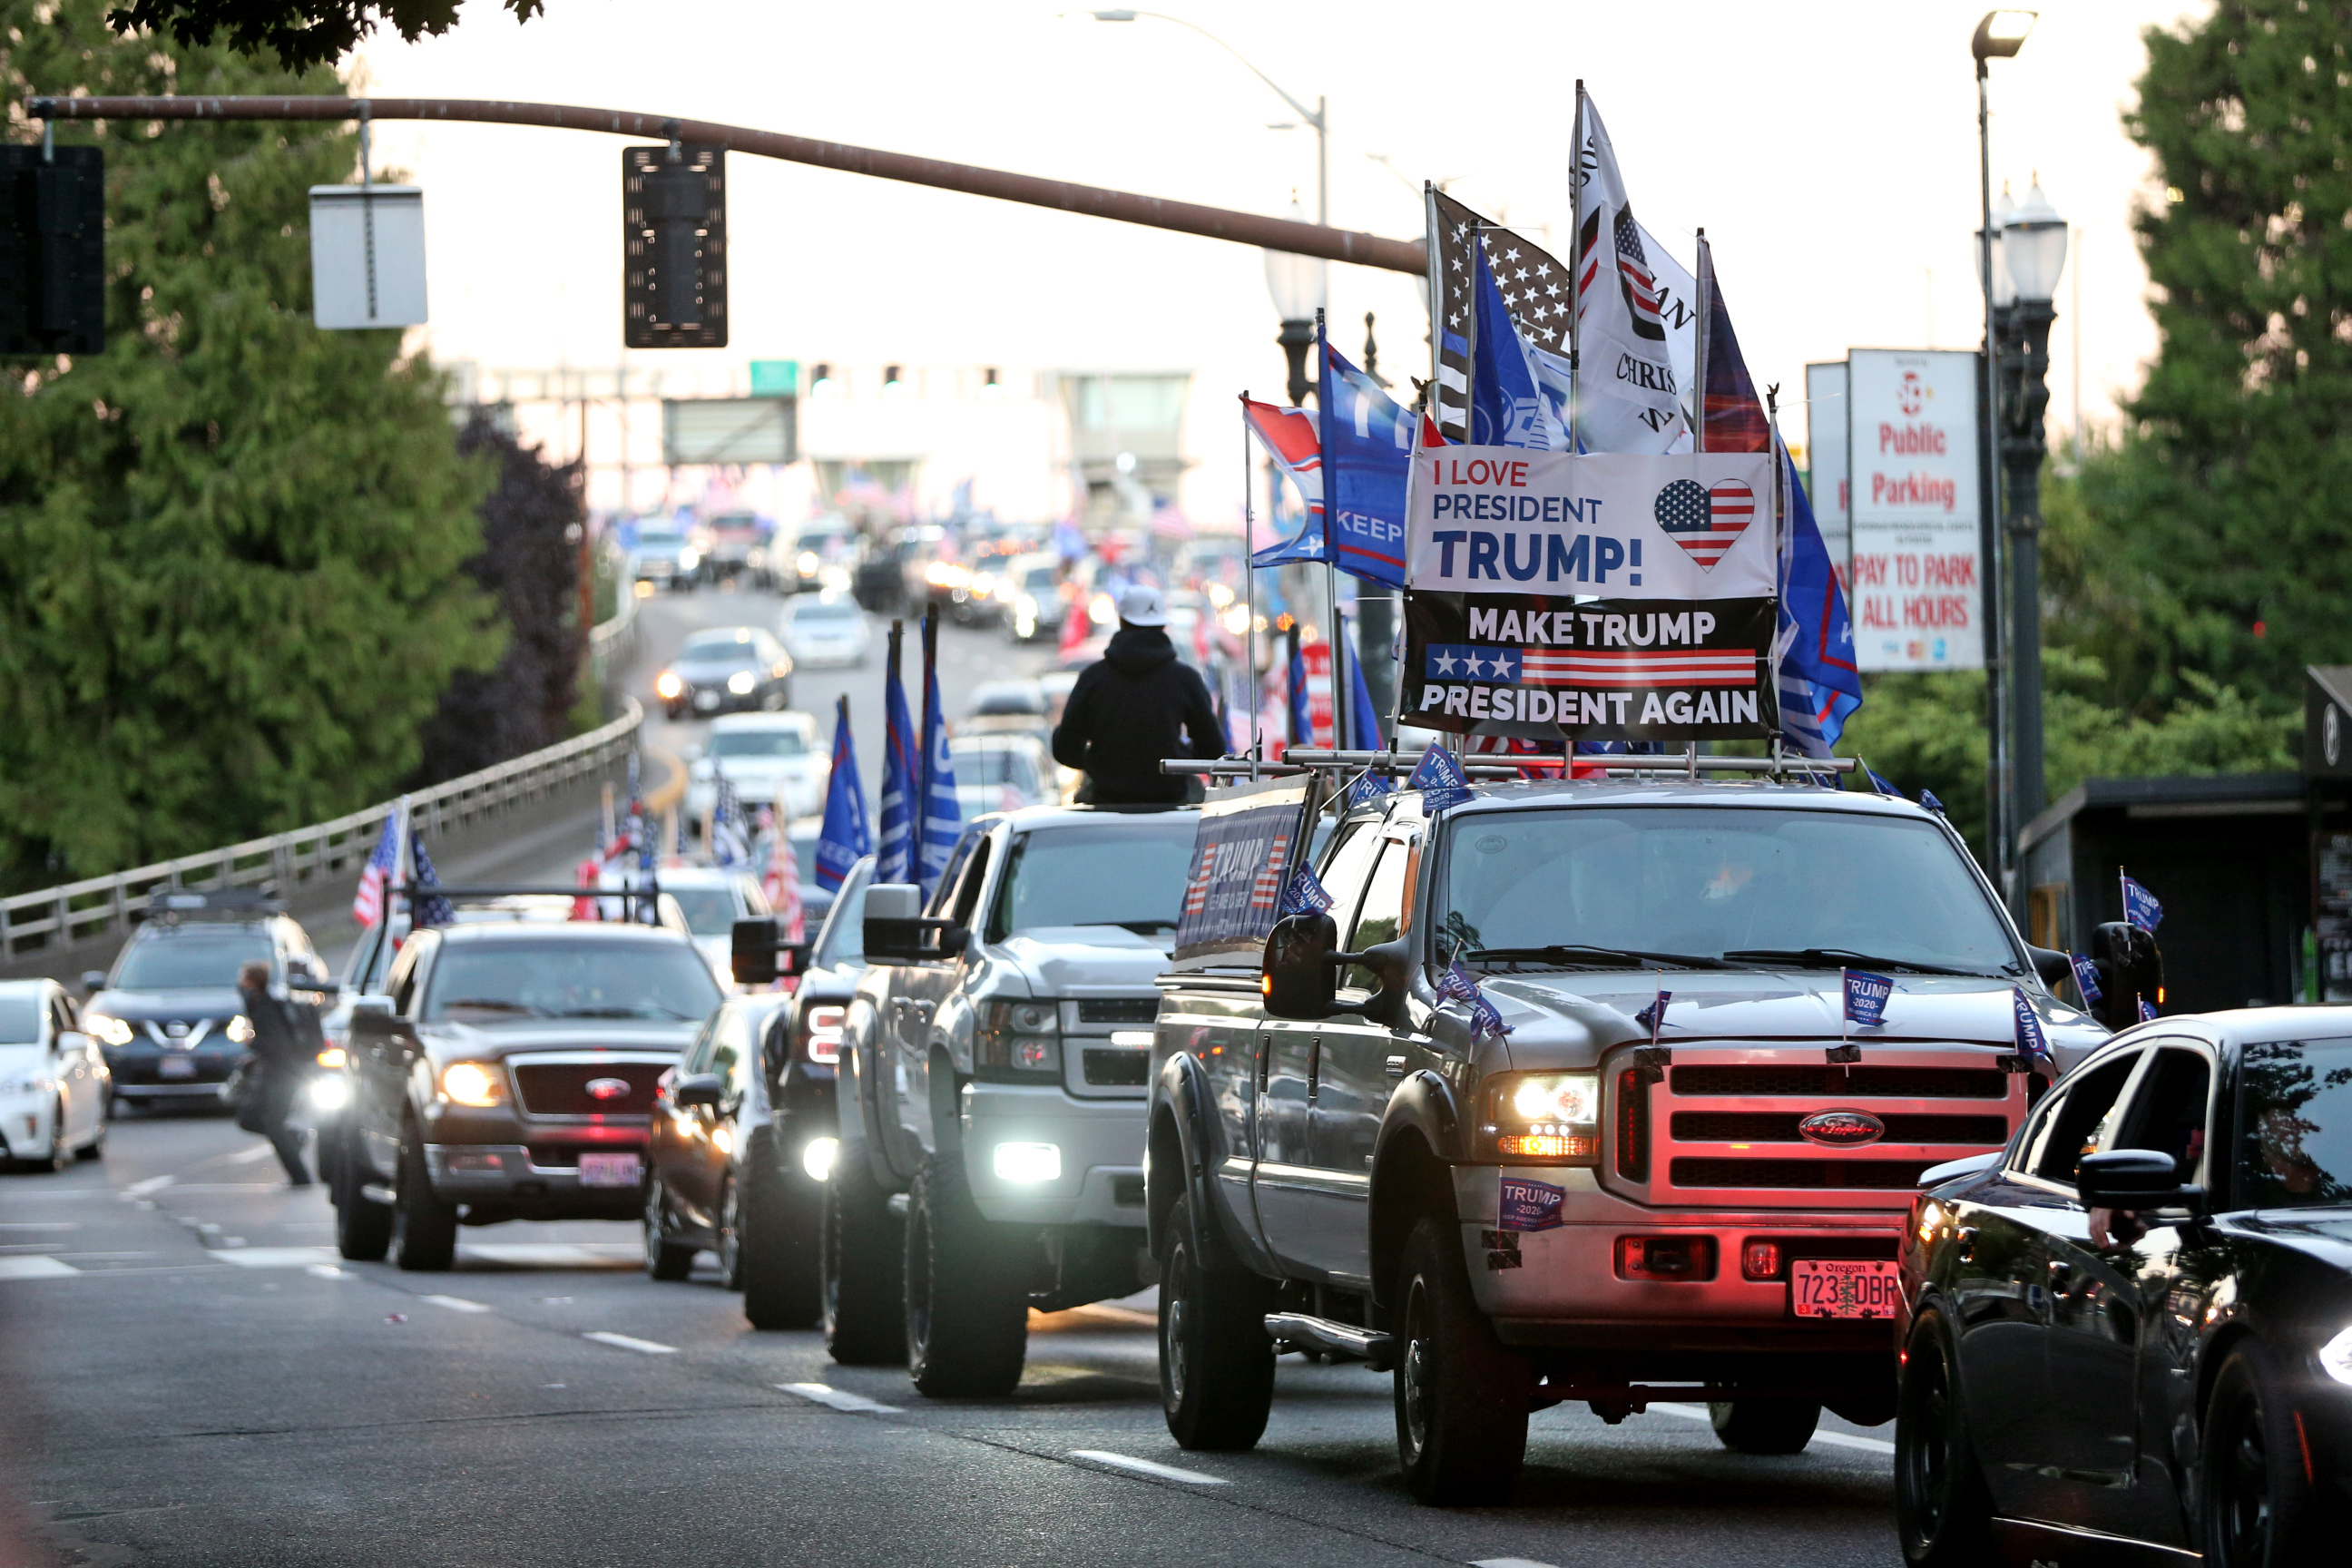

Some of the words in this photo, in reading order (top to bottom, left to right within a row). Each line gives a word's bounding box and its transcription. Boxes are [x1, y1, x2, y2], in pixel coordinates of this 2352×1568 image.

[1879, 421, 1946, 456] Public
[1433, 459, 1441, 485] I
[1452, 459, 1529, 487] LOVE
[1433, 494, 1602, 524] PRESIDENT
[1872, 471, 1955, 514] Parking
[1336, 508, 1404, 543] KEEP
[1432, 530, 1642, 587] TRUMP!
[1853, 554, 1888, 586] PAY
[1895, 554, 1919, 586] TO
[1923, 554, 1975, 586] PARK
[1468, 606, 1574, 645] MAKE
[1579, 611, 1716, 647] TRUMP
[1862, 594, 1897, 629] ALL
[1903, 594, 1968, 629] HOURS
[1419, 684, 1632, 725] PRESIDENT
[1639, 690, 1759, 725] AGAIN
[1210, 838, 1264, 884] TRUMP
[2127, 883, 2159, 910] TRUMP
[1847, 978, 1889, 1000] TRUMP
[2014, 995, 2039, 1049] TRUMP
[1504, 1185, 1561, 1205] TRUMP
[1826, 1262, 1867, 1275] Oregon
[1798, 1274, 1838, 1304] 723
[1855, 1275, 1896, 1305] DBR
